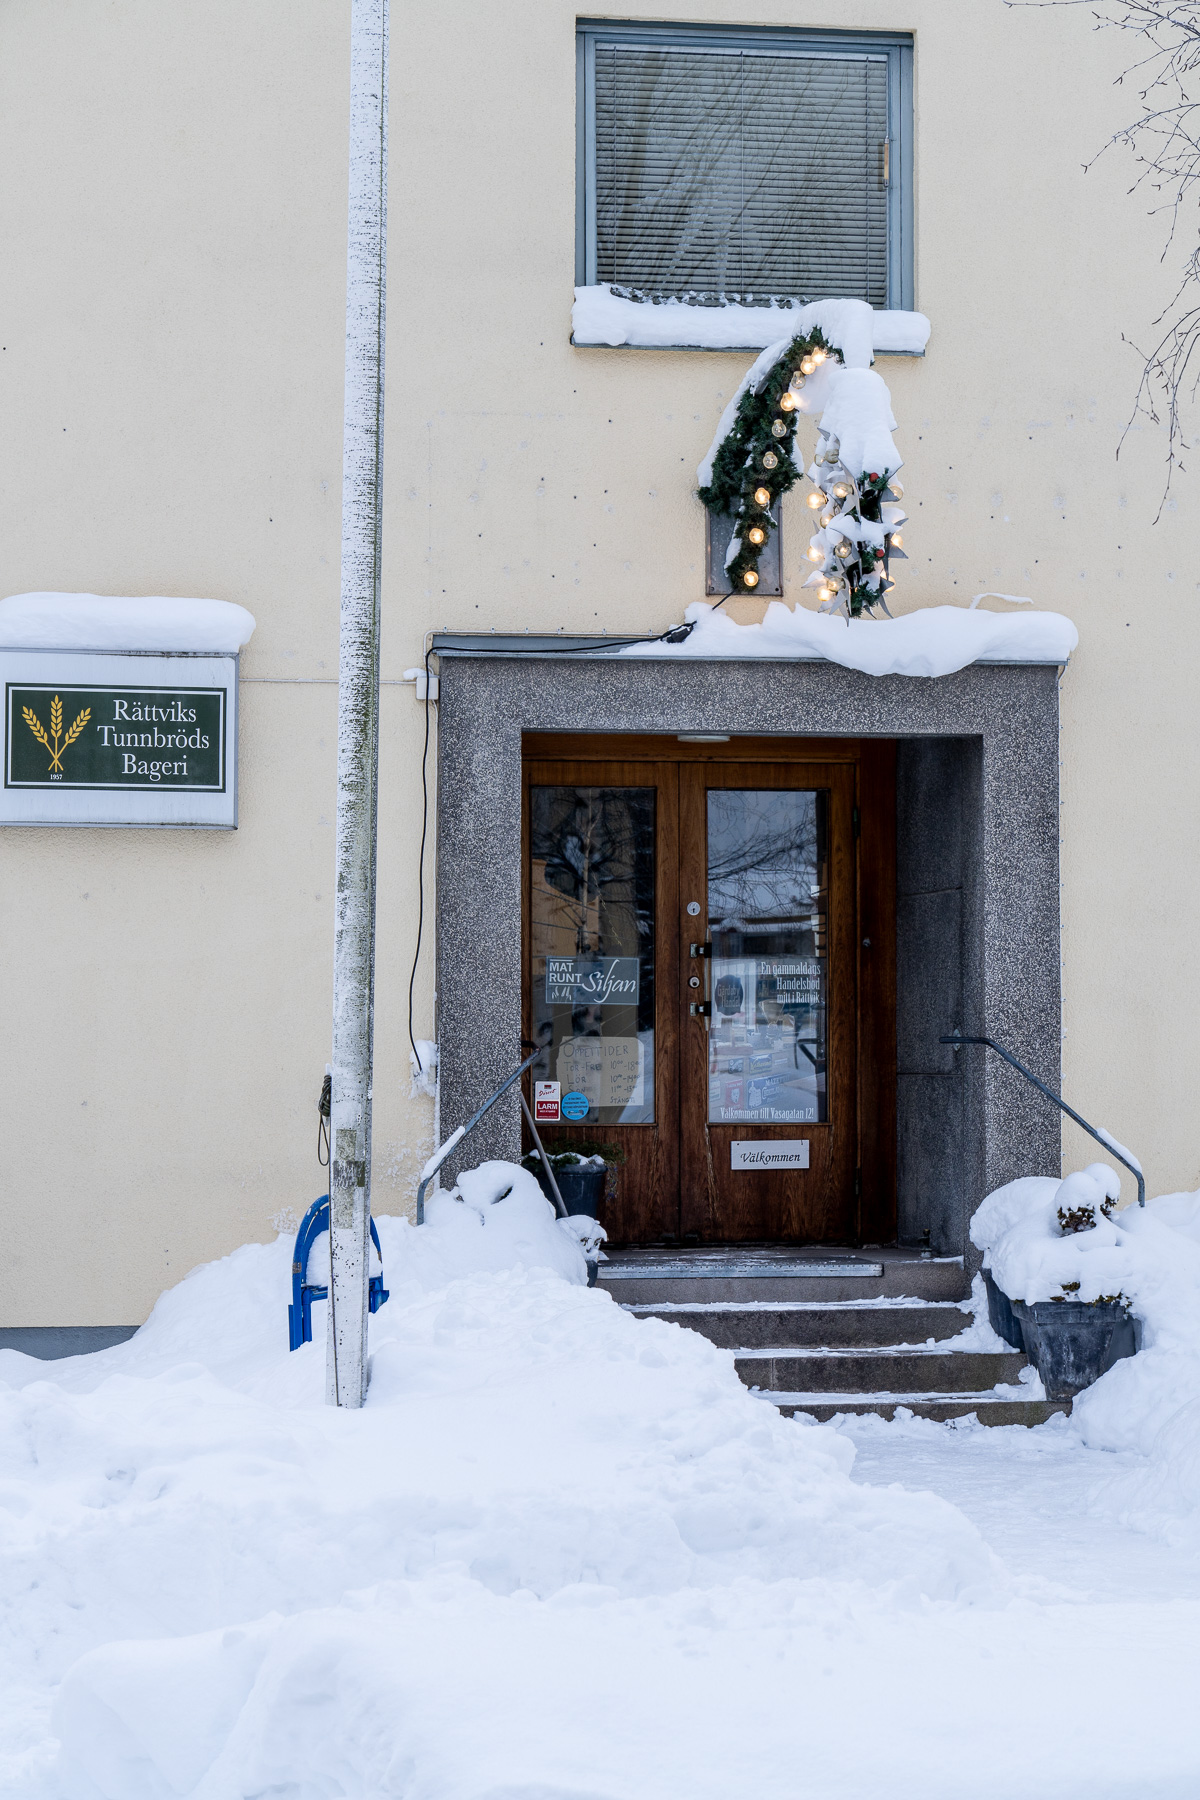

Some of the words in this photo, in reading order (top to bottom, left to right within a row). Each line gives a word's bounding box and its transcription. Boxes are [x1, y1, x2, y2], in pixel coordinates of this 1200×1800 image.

[113, 699, 197, 722] Rättviks
[97, 725, 210, 749] Tunnbröds
[121, 753, 188, 781] Bageri
[549, 962, 574, 972] MAT
[761, 961, 771, 974] En
[772, 961, 821, 977] gammaldags
[549, 973, 582, 983] RUNT
[581, 958, 636, 1003] Siljan
[776, 977, 820, 990] Handelsbod
[776, 991, 791, 1004] mitt
[796, 991, 820, 1004] Rättvik
[720, 1107, 759, 1119] Välkommen
[759, 1107, 769, 1119] till
[770, 1107, 803, 1121] Vasagatan
[804, 1108, 814, 1119] 12!
[740, 1152, 801, 1164] Välkommen
